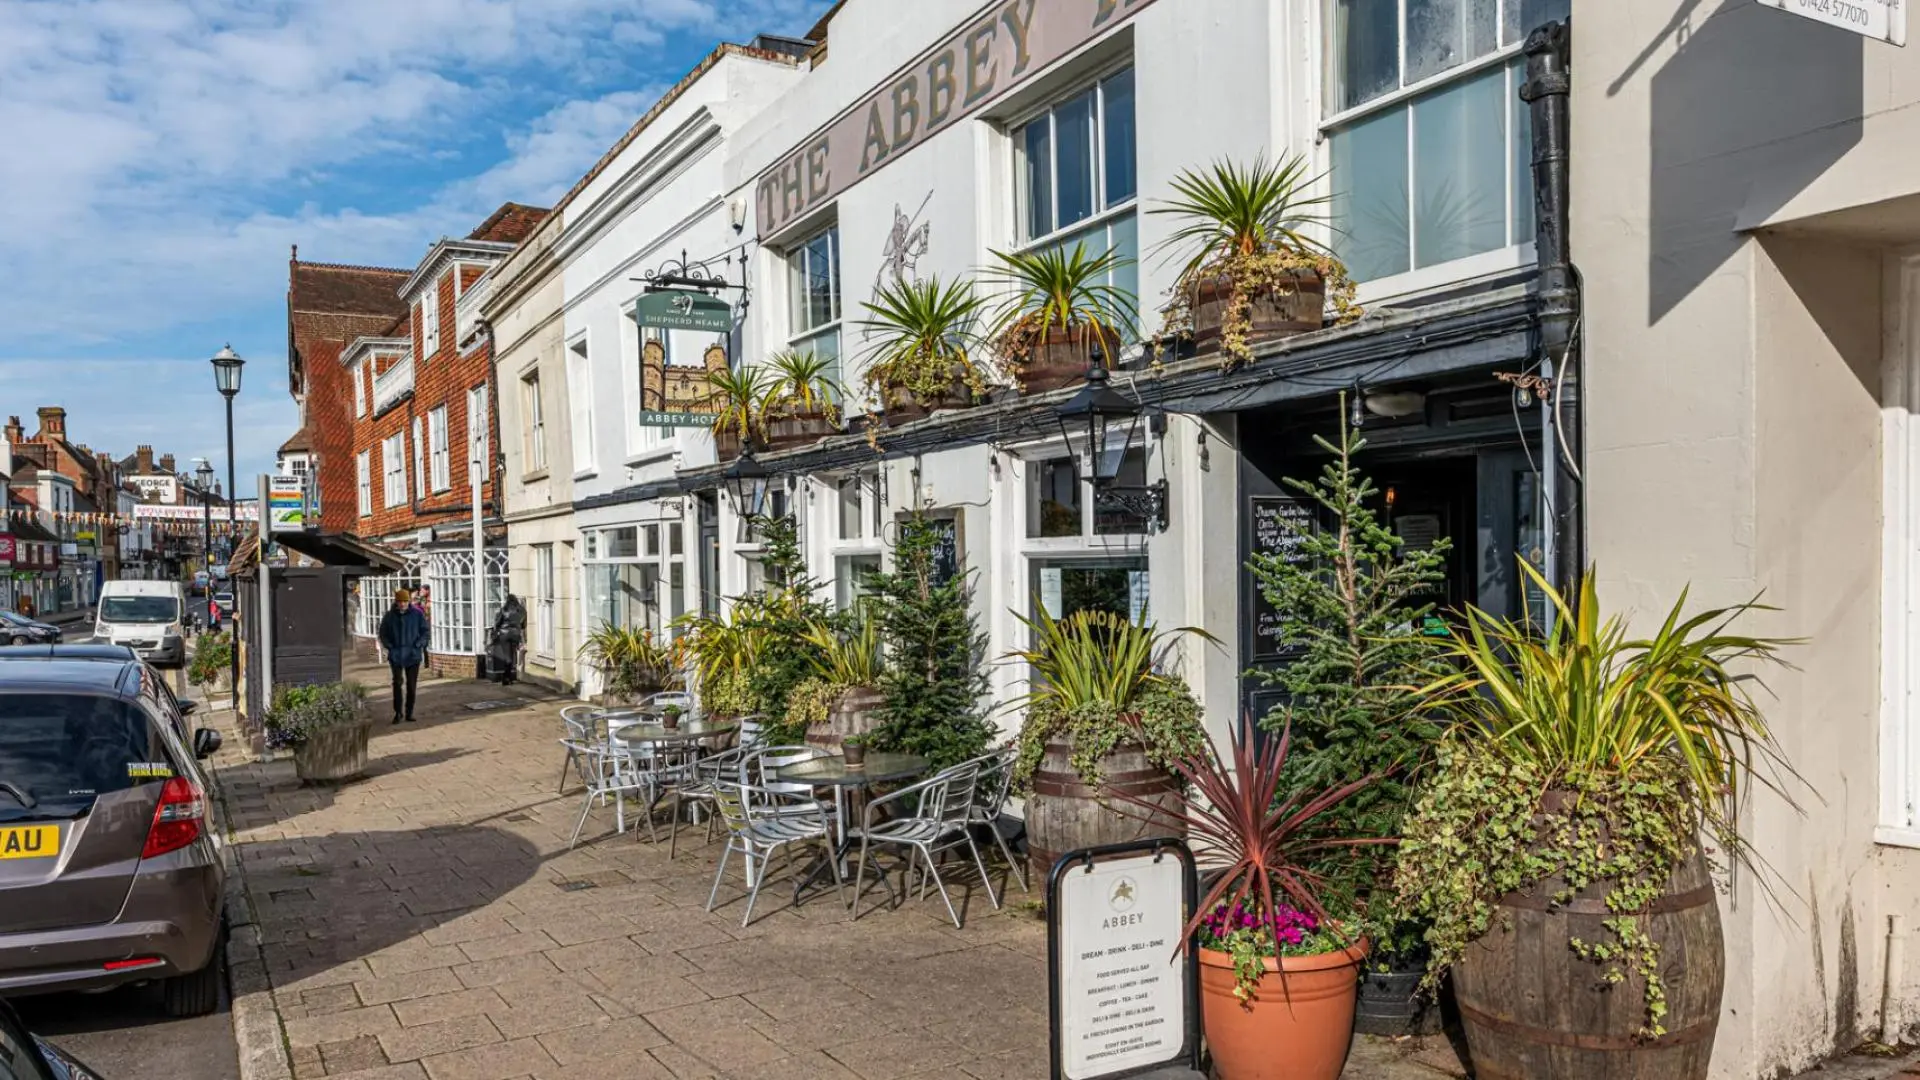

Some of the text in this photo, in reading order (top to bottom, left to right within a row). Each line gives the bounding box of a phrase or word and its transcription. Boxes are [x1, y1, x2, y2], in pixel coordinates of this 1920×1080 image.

[1832, 0, 1869, 26] 577070
[760, 0, 1035, 231] THE ABBEY
[645, 315, 726, 328] SHEPHERD NEAME
[646, 414, 686, 424] ABBEY
[0, 829, 42, 853] AU
[1102, 912, 1144, 929] ABBEY
[1081, 939, 1164, 960] DREAM DRINK DELI DINE
[1098, 998, 1118, 1007] COFFEE
